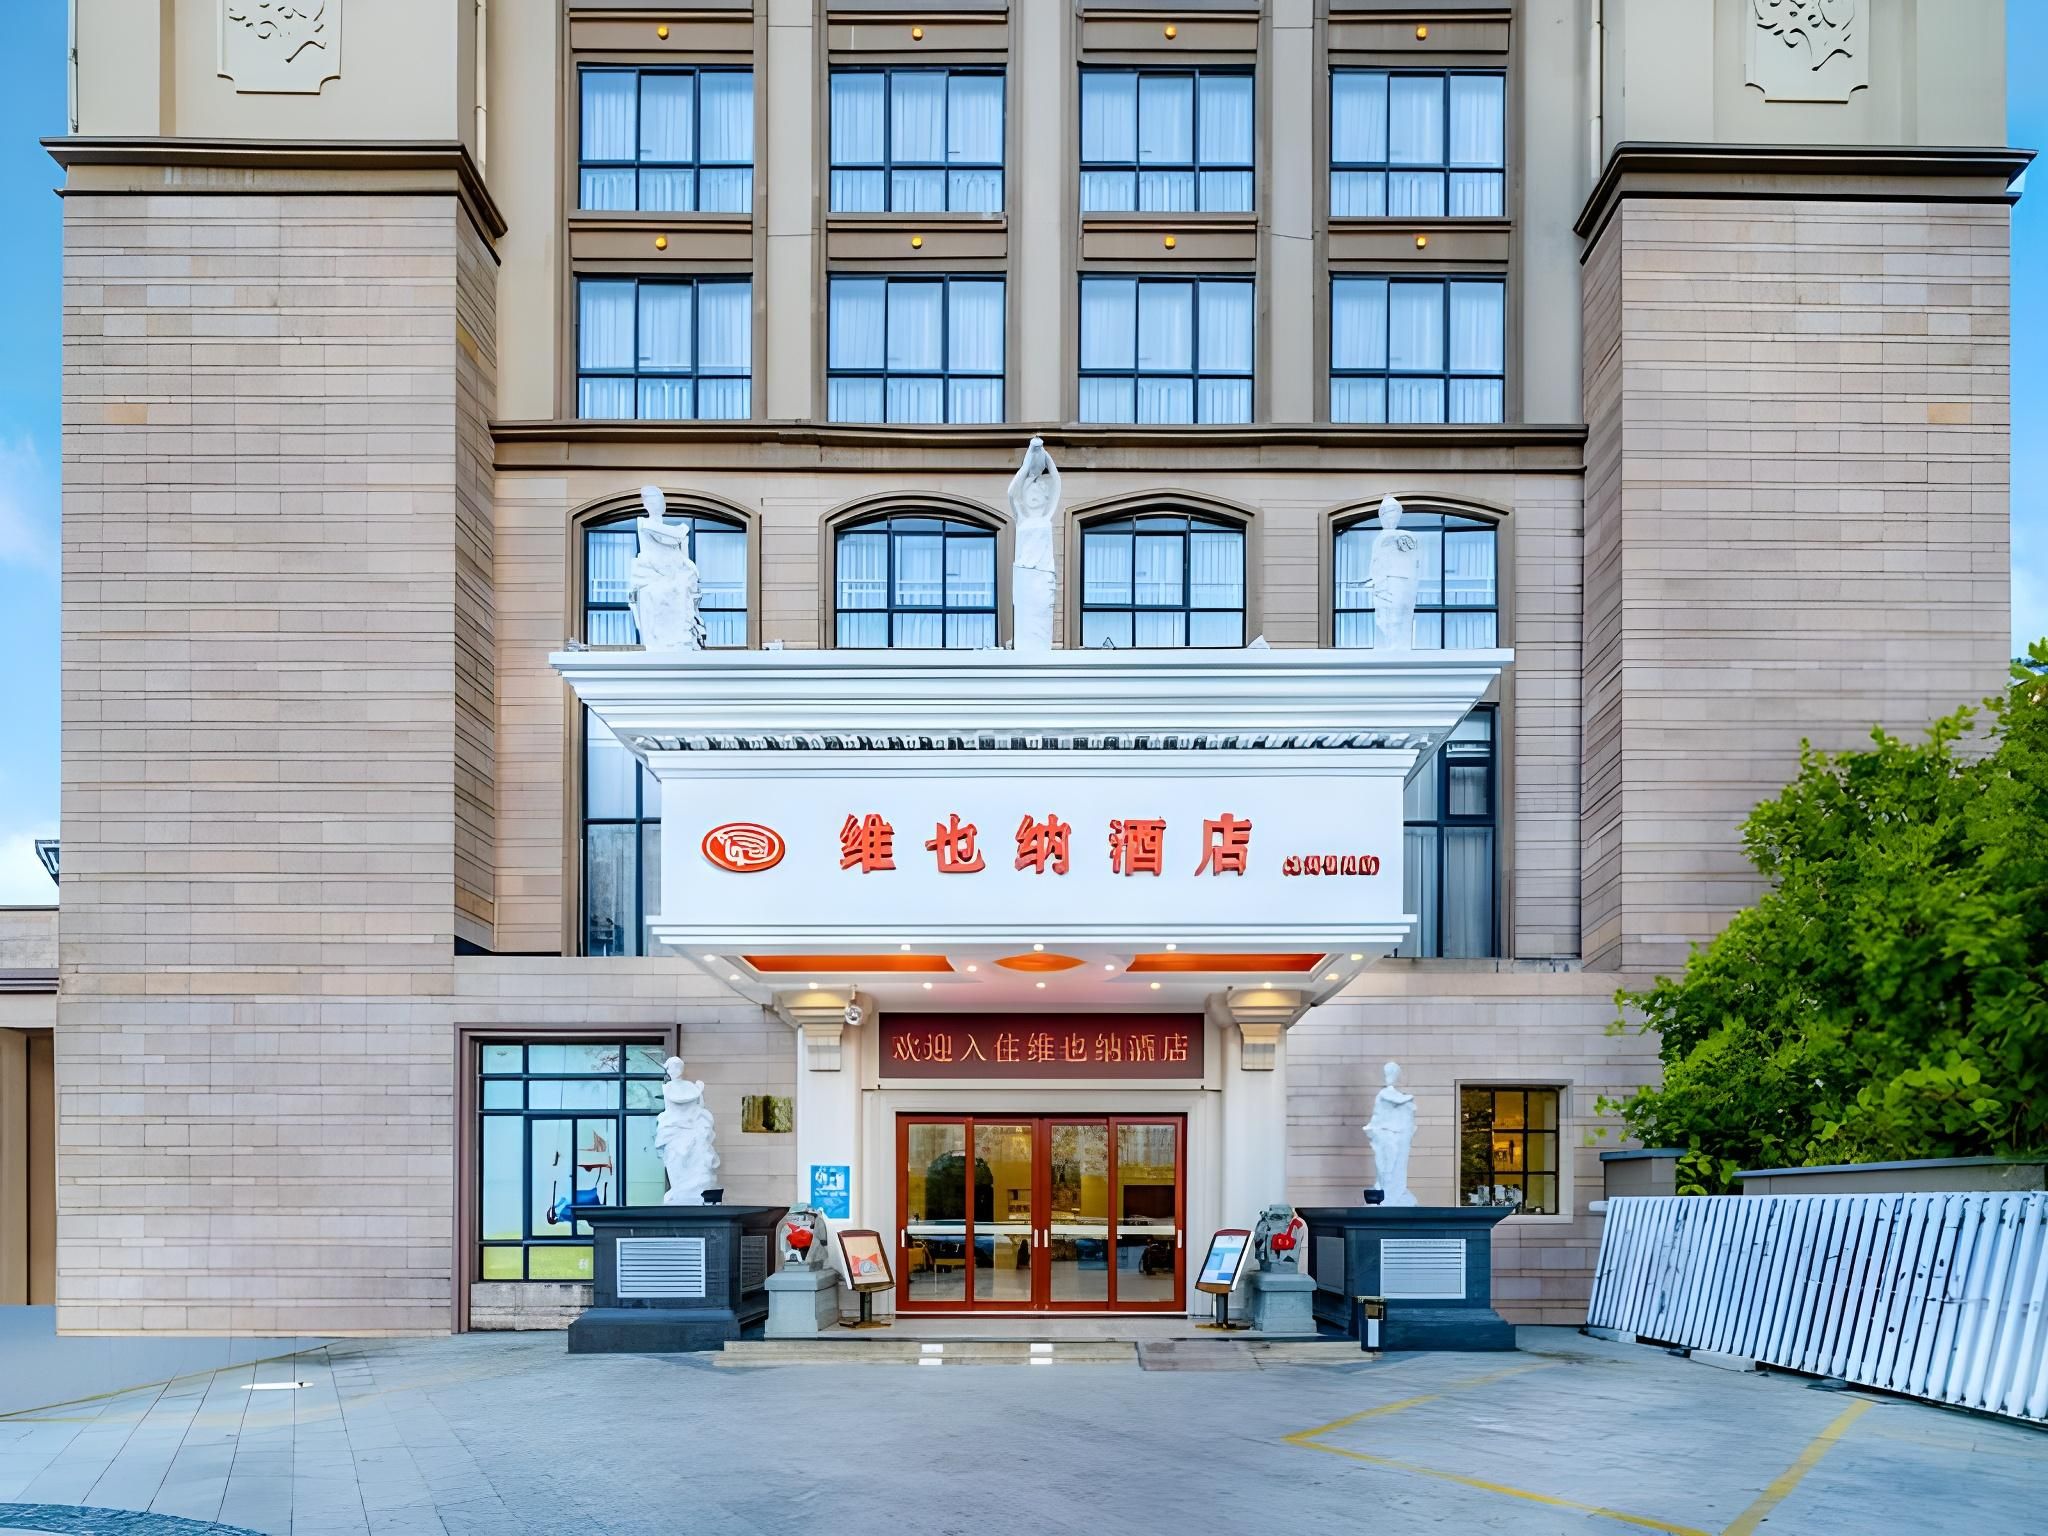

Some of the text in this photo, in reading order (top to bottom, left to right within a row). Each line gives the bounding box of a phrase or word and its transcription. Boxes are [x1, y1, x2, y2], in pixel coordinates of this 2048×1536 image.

[839, 812, 1252, 877] 维也纳酒店
